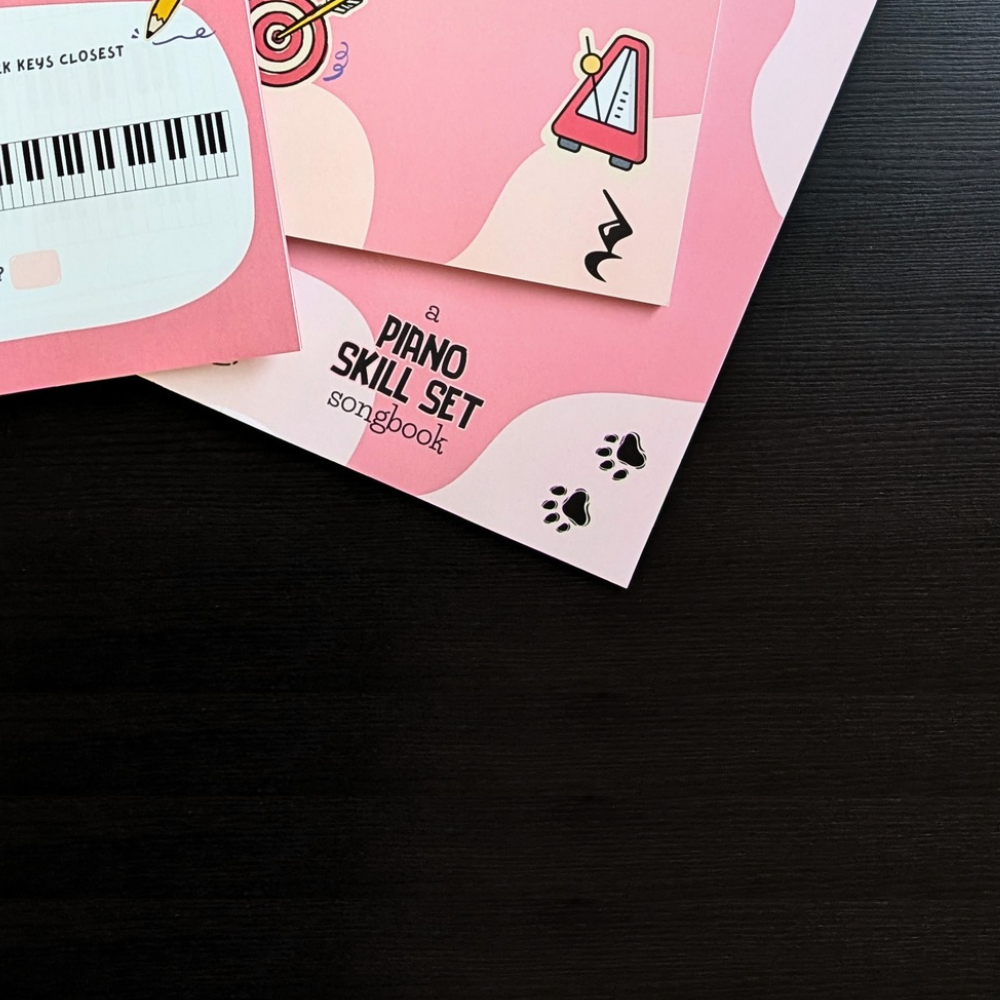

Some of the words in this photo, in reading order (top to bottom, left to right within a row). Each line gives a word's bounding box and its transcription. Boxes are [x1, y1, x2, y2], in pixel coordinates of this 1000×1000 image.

[17, 56, 53, 71] KEYS
[60, 45, 123, 65] CLOSEST
[425, 306, 439, 323] a
[376, 315, 467, 379] PIANO
[330, 341, 411, 404] SKILL
[418, 380, 484, 429] SET
[327, 391, 448, 455] songbook
